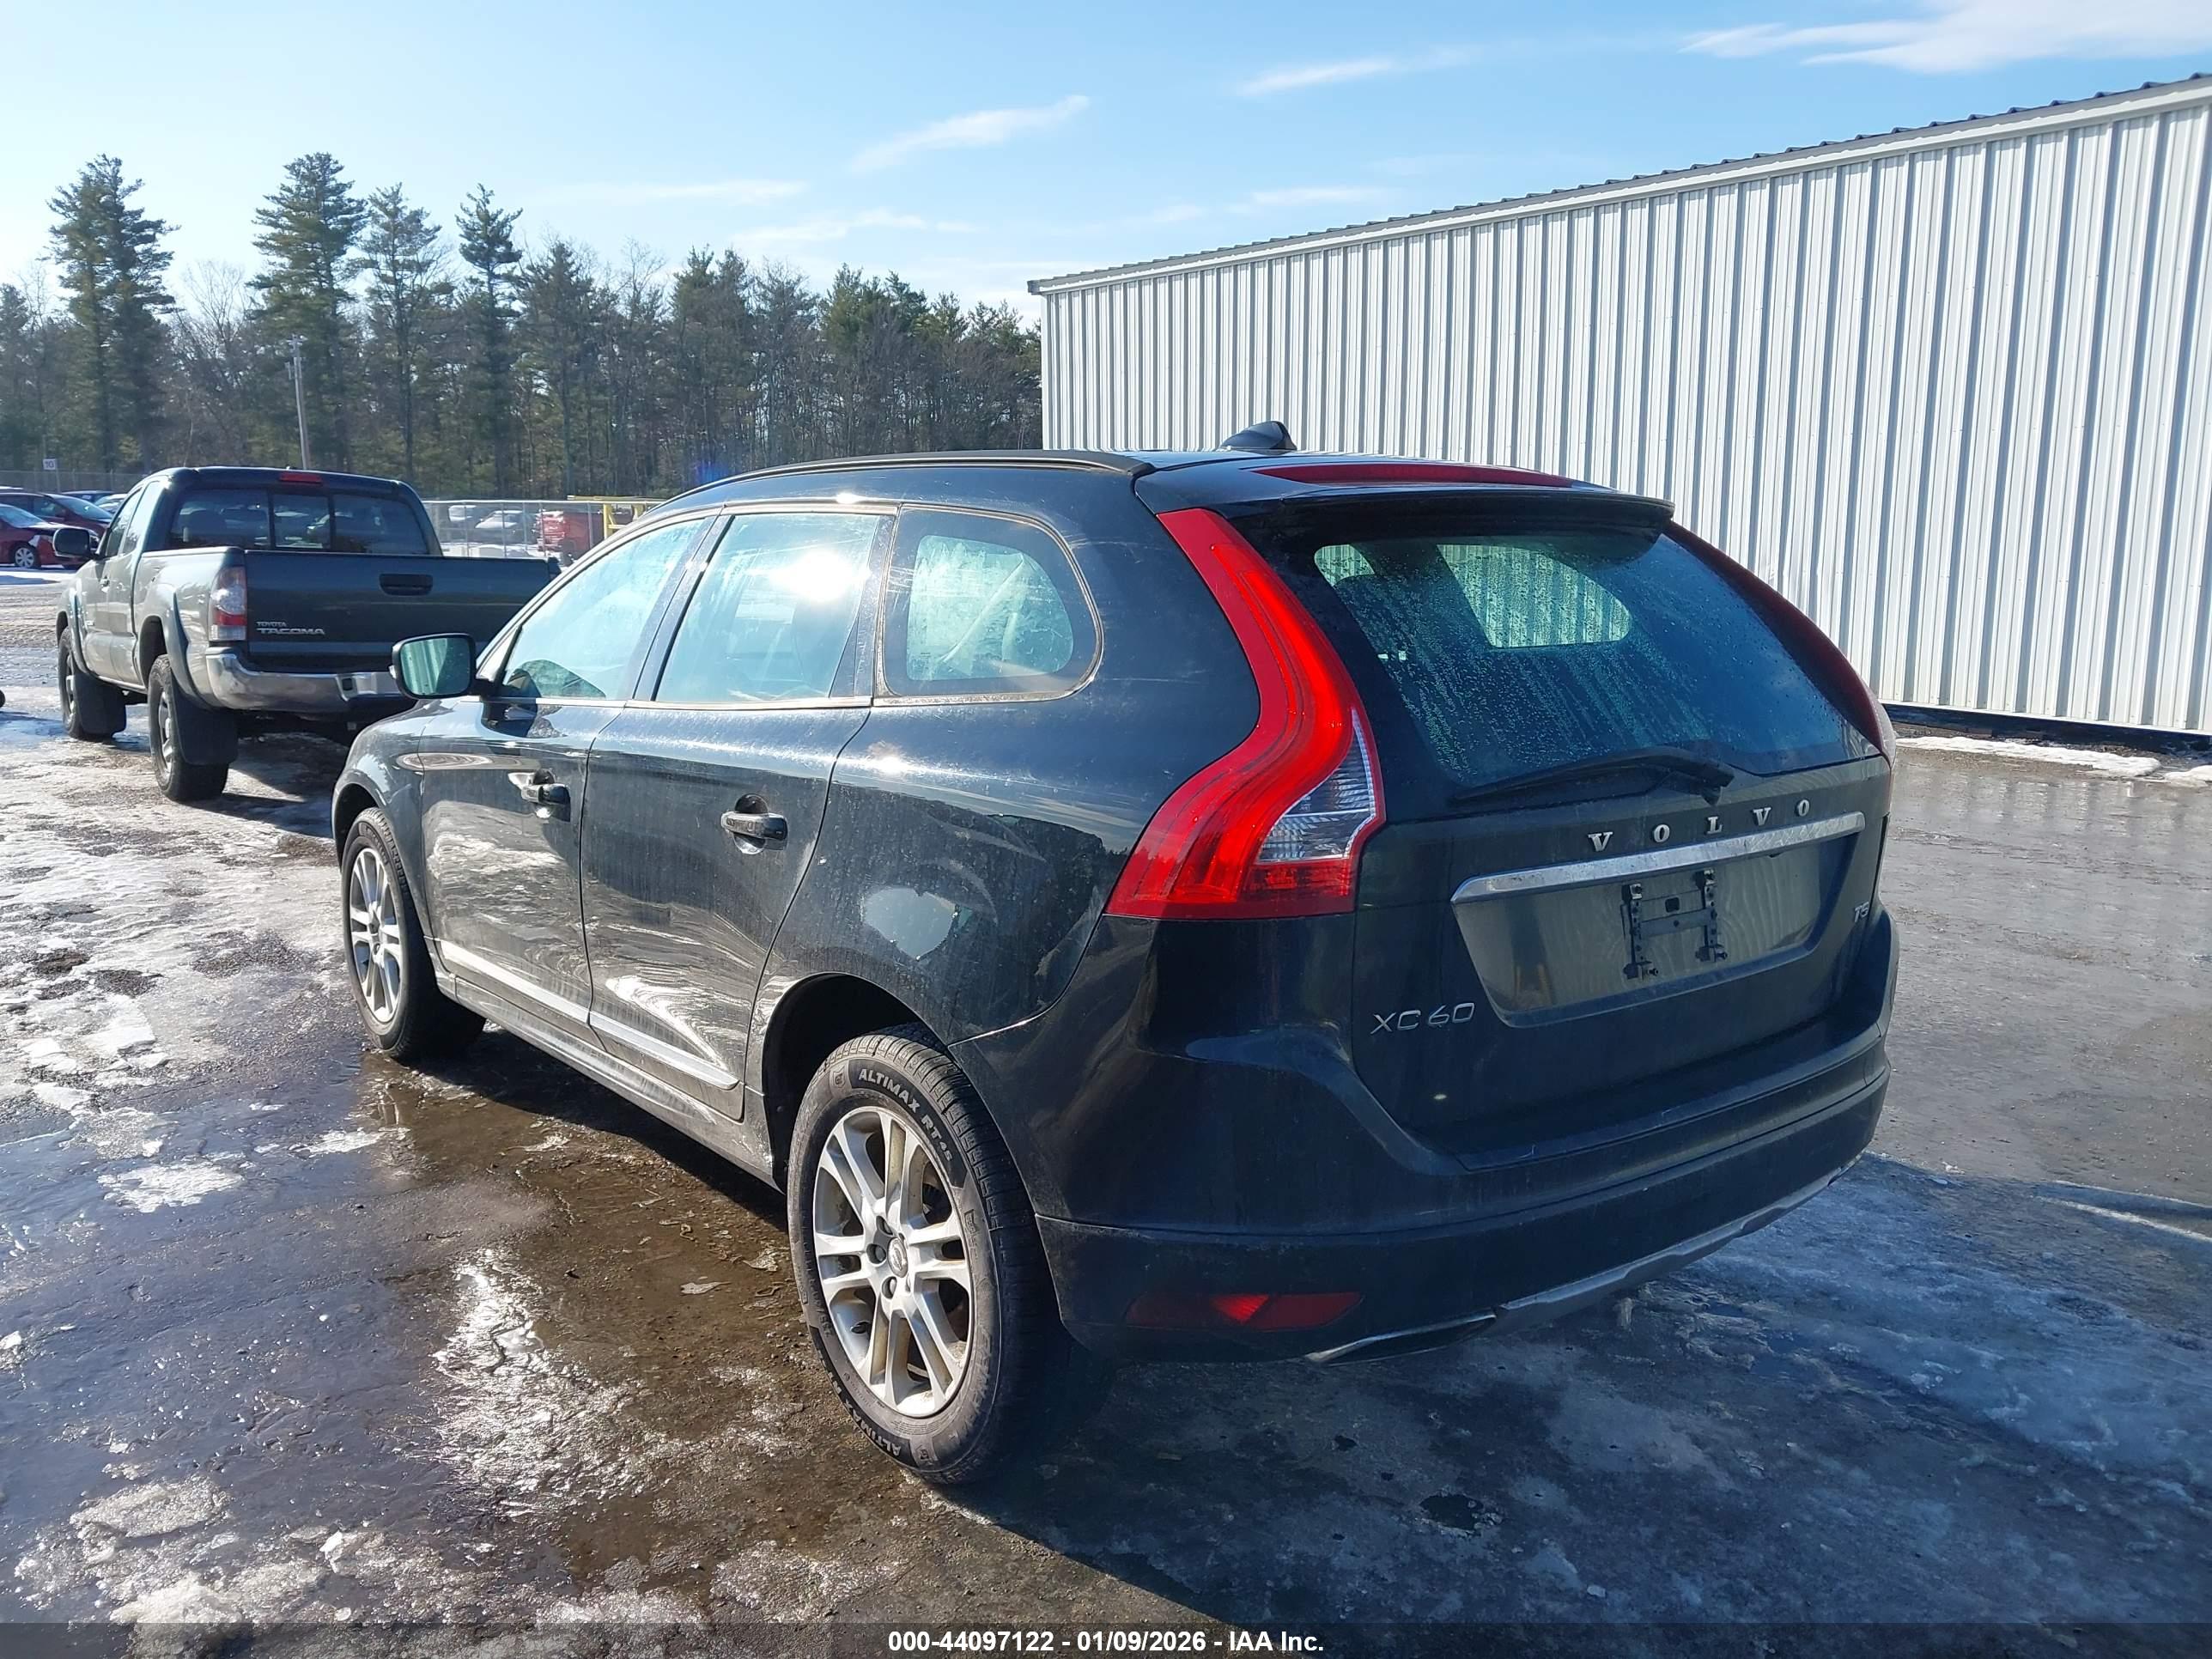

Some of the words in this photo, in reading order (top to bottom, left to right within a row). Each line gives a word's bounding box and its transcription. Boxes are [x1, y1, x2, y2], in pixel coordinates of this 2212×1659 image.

[1588, 799, 1810, 852] VOLVO
[858, 1068, 921, 1114] ALTIMAX
[844, 1399, 902, 1456] ALTIMAX
